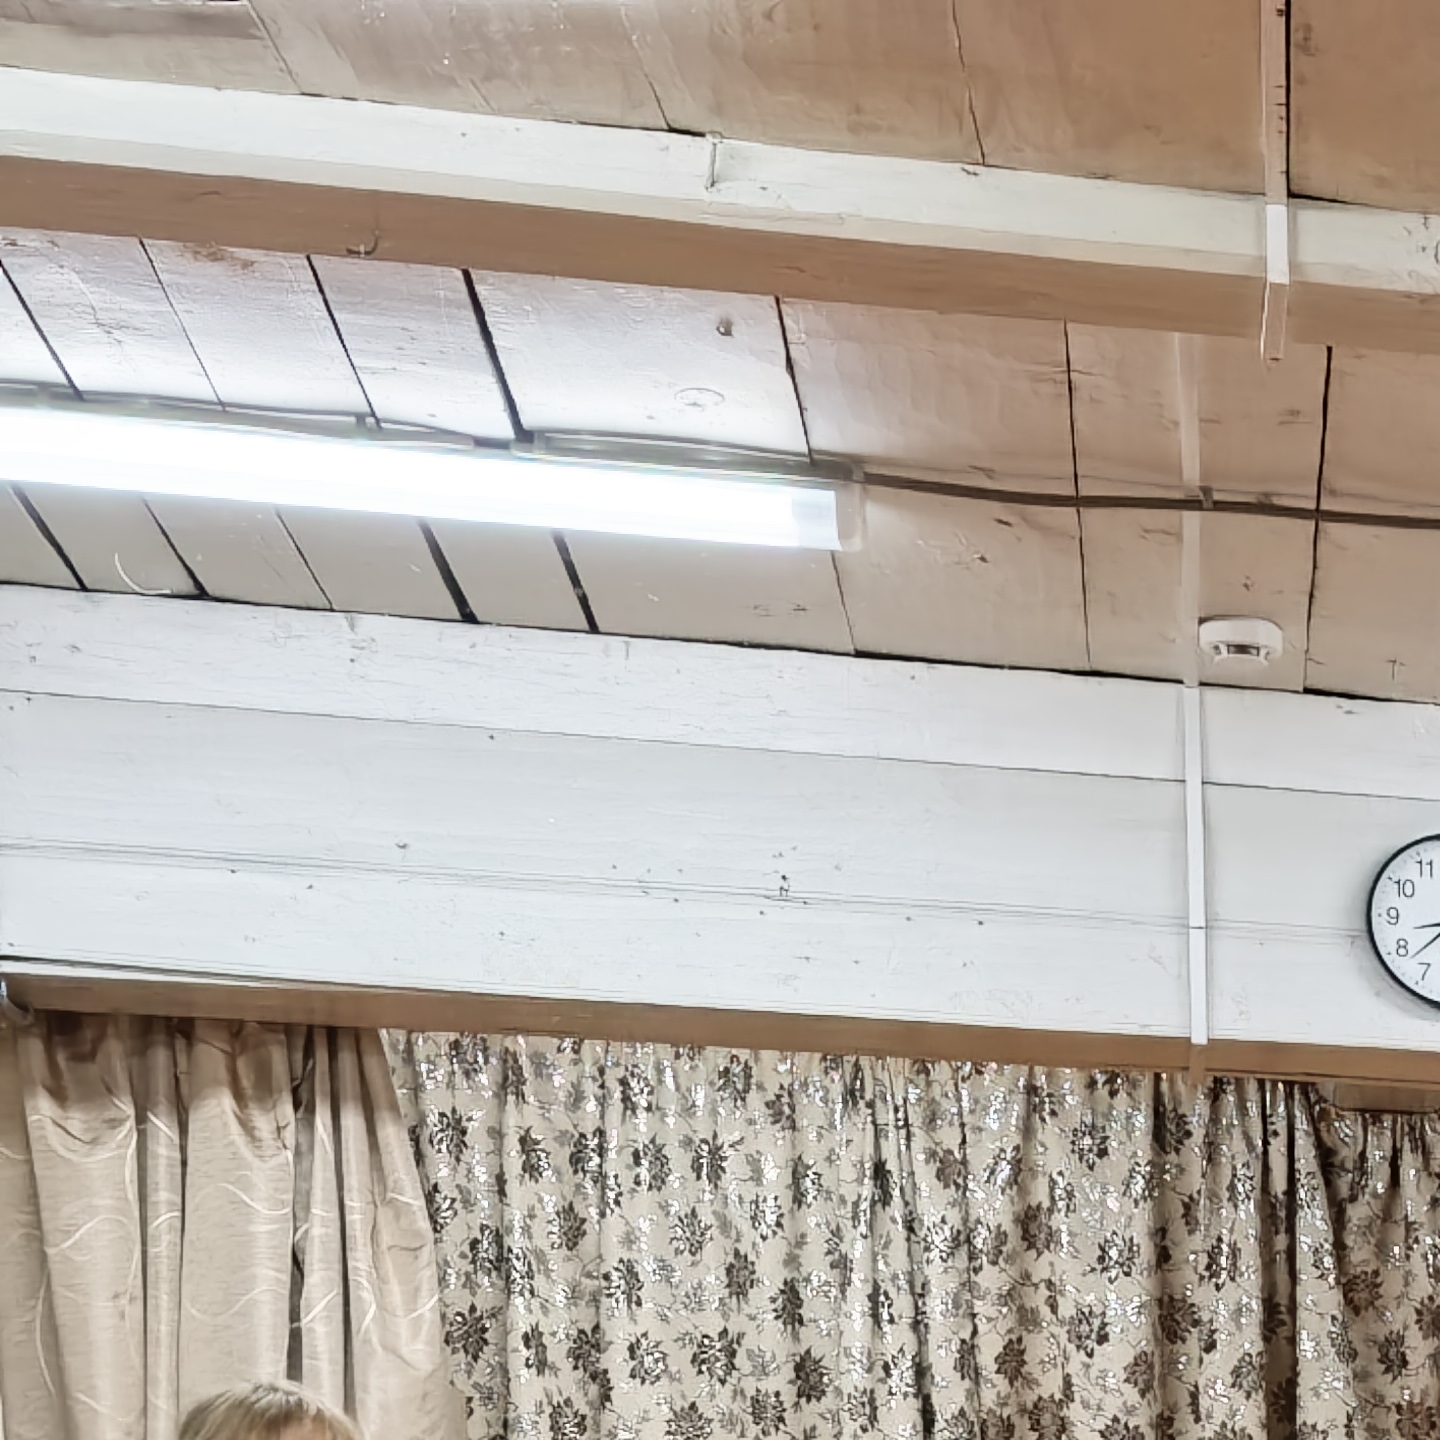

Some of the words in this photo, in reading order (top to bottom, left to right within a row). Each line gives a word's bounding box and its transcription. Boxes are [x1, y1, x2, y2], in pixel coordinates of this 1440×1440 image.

[1415, 859, 1433, 879] 11
[1394, 879, 1415, 898] 10
[1386, 907, 1399, 925] 9
[1396, 939, 1408, 957] 8
[1418, 963, 1431, 980] 7
